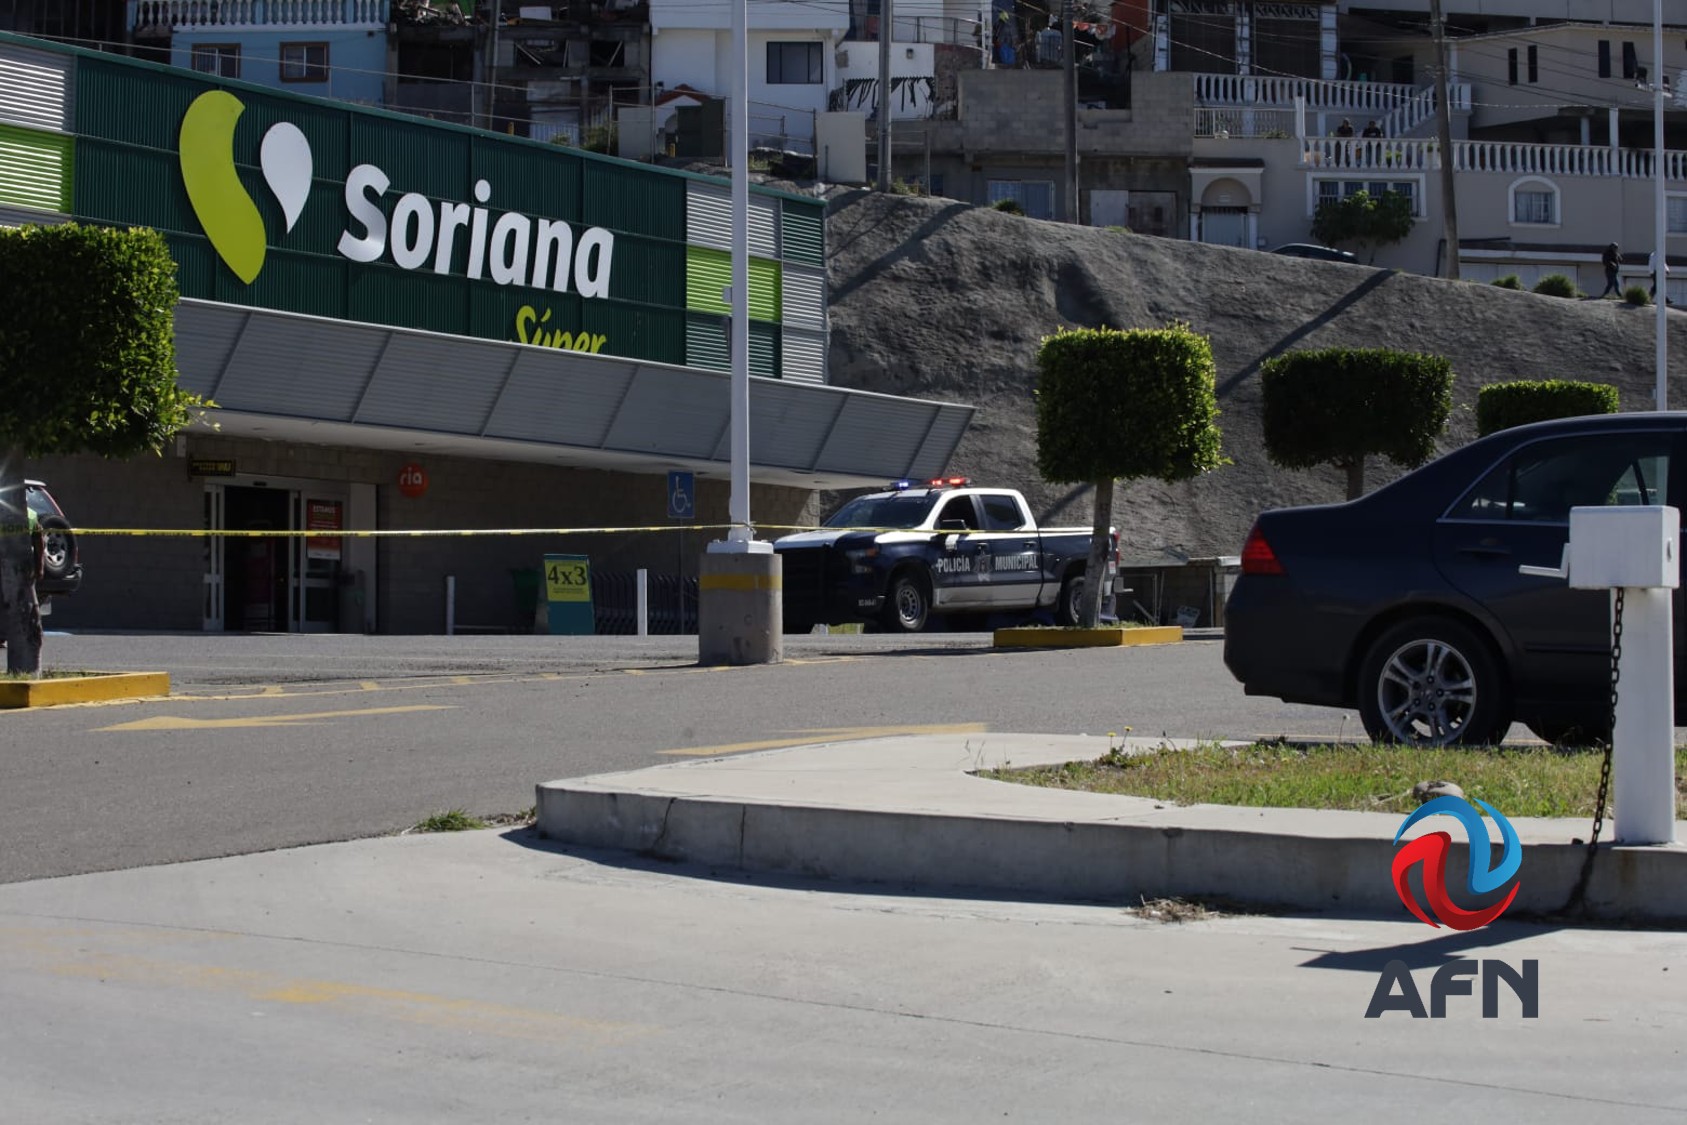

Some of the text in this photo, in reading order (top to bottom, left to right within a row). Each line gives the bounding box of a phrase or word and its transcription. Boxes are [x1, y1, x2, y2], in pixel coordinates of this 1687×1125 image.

[337, 163, 615, 299] Soriana
[400, 466, 423, 485] ria
[938, 554, 1039, 573] POLICÍA MUNICIPAL
[548, 565, 587, 586] 4x3
